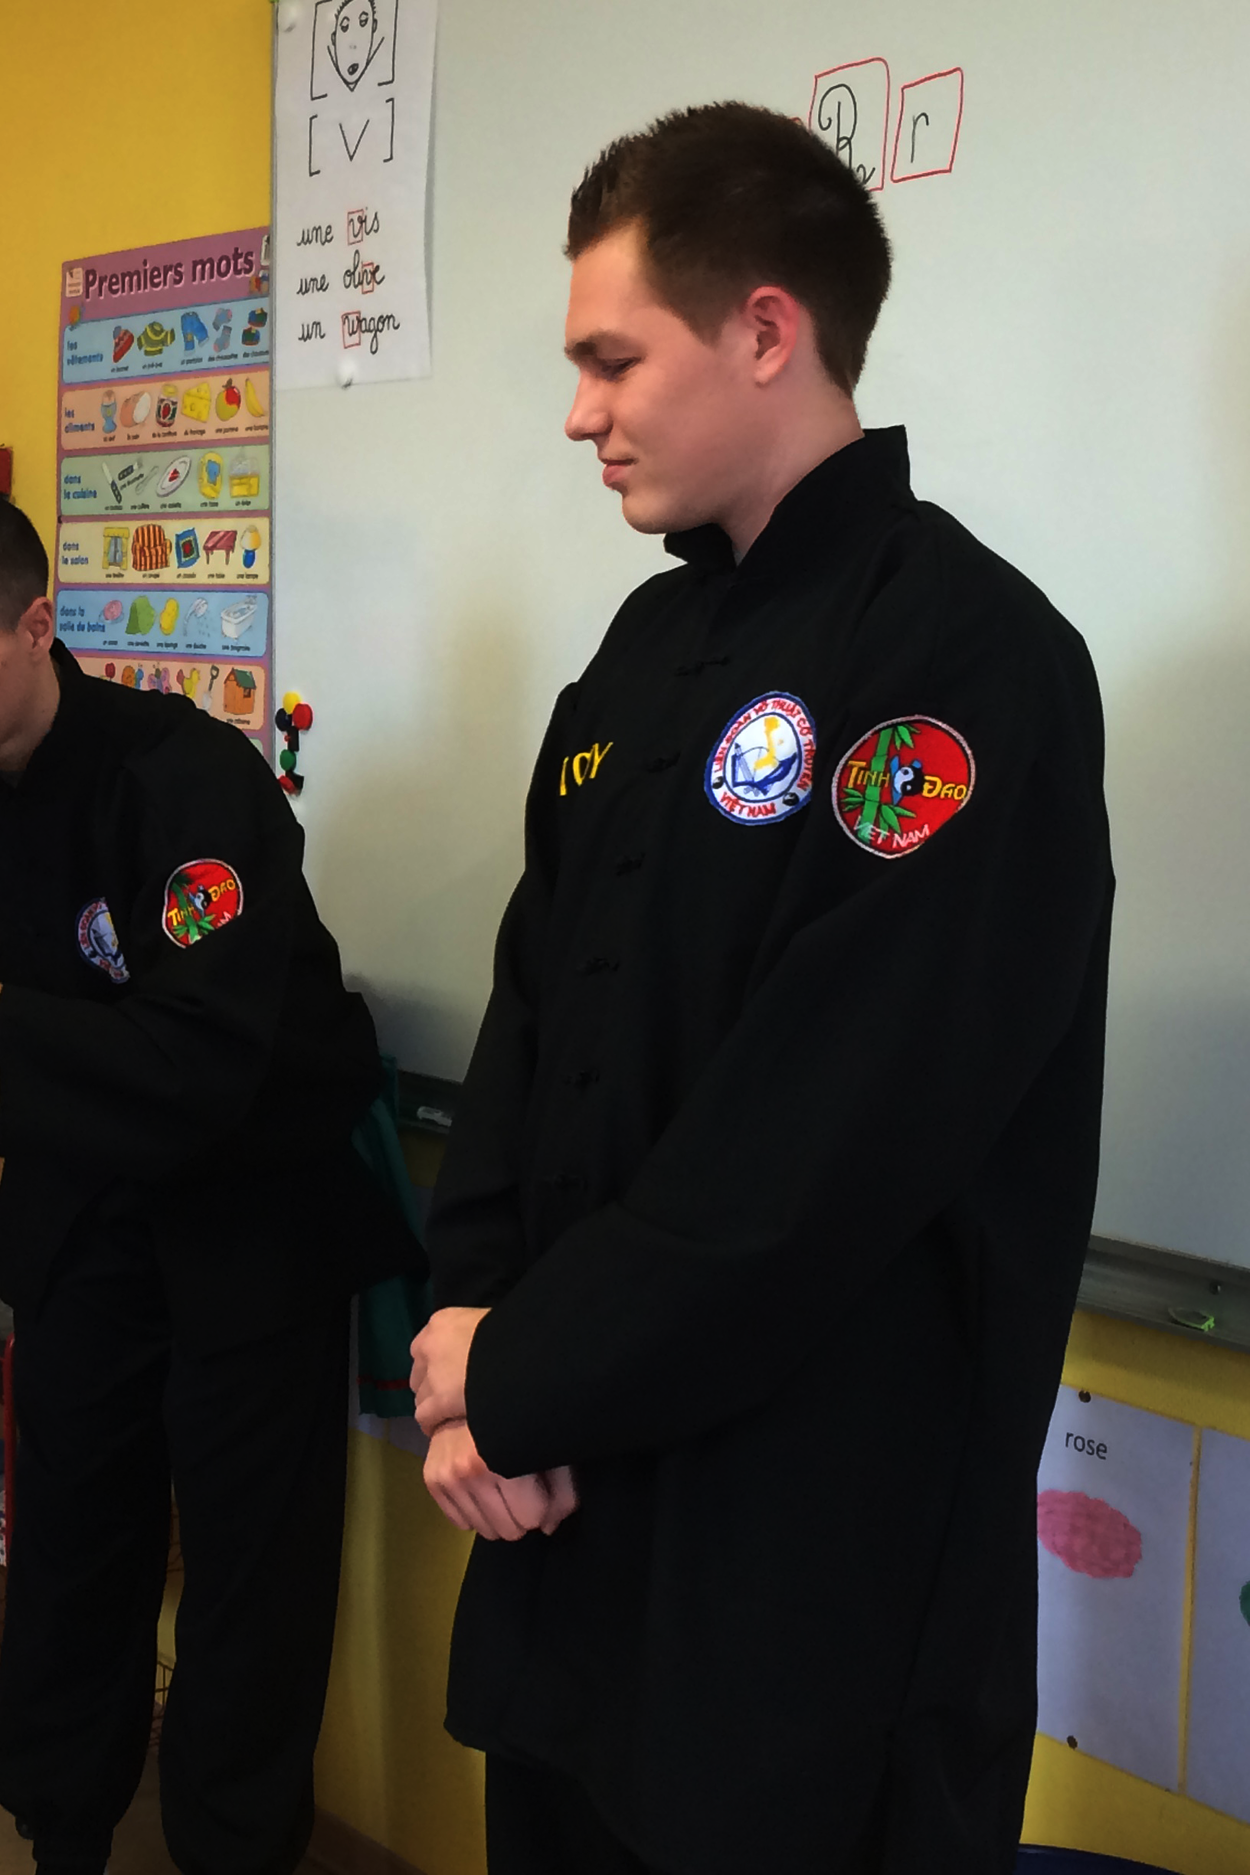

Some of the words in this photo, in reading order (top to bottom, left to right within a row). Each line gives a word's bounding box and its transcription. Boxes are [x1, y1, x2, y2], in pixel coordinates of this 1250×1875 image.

[297, 225, 334, 246] une
[349, 207, 380, 235] vis
[85, 258, 185, 299] Premiers
[191, 246, 255, 283] mots
[297, 273, 330, 296] une
[343, 250, 386, 289] olive
[298, 322, 326, 342] un
[345, 312, 401, 355] wagon
[891, 823, 931, 849] NAM
[1065, 1428, 1109, 1461] rose
